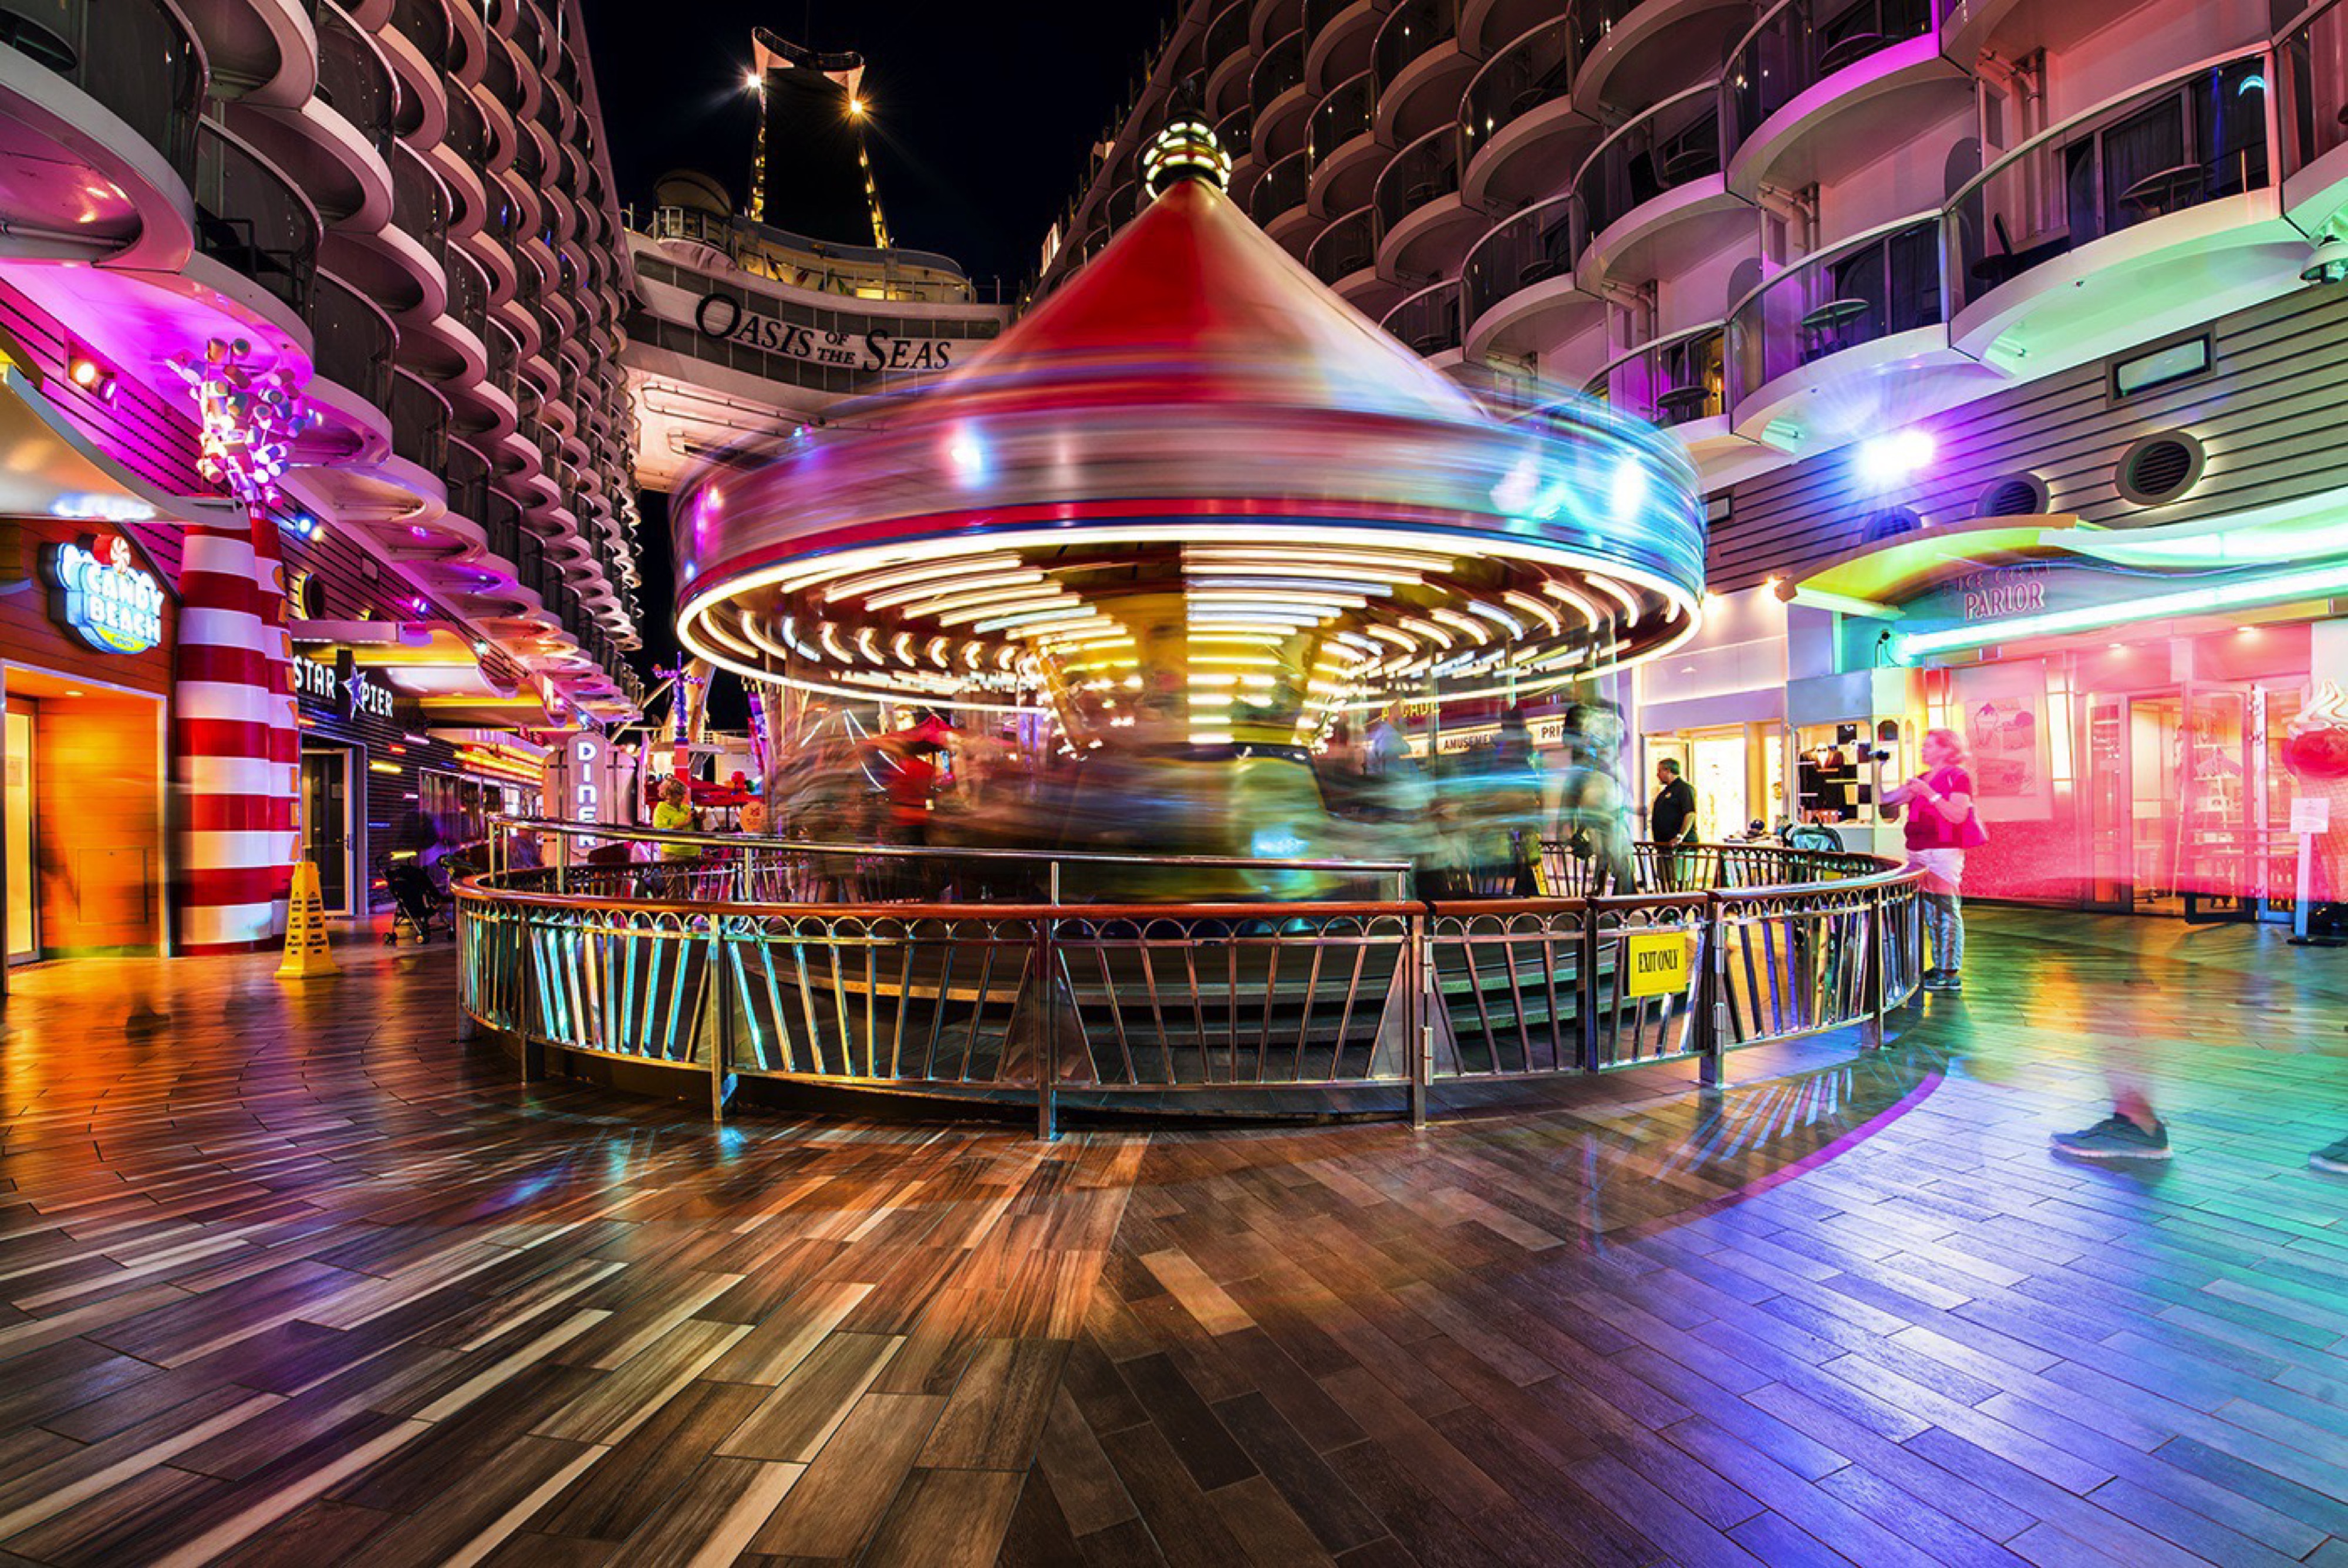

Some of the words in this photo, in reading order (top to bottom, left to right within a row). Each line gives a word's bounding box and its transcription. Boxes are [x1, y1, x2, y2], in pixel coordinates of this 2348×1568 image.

[696, 293, 814, 358] OASIS
[825, 332, 849, 346] OF
[818, 348, 856, 365] THE
[862, 329, 952, 373] SEAS
[87, 564, 164, 616] CANDY
[1965, 580, 2045, 622] PARLOR
[90, 596, 161, 643] BEACH
[295, 654, 336, 700] STAR
[362, 680, 393, 718] PIER
[1541, 724, 1566, 739] PRI
[1638, 951, 1657, 973] EXIT
[1657, 949, 1679, 972] ONLY
